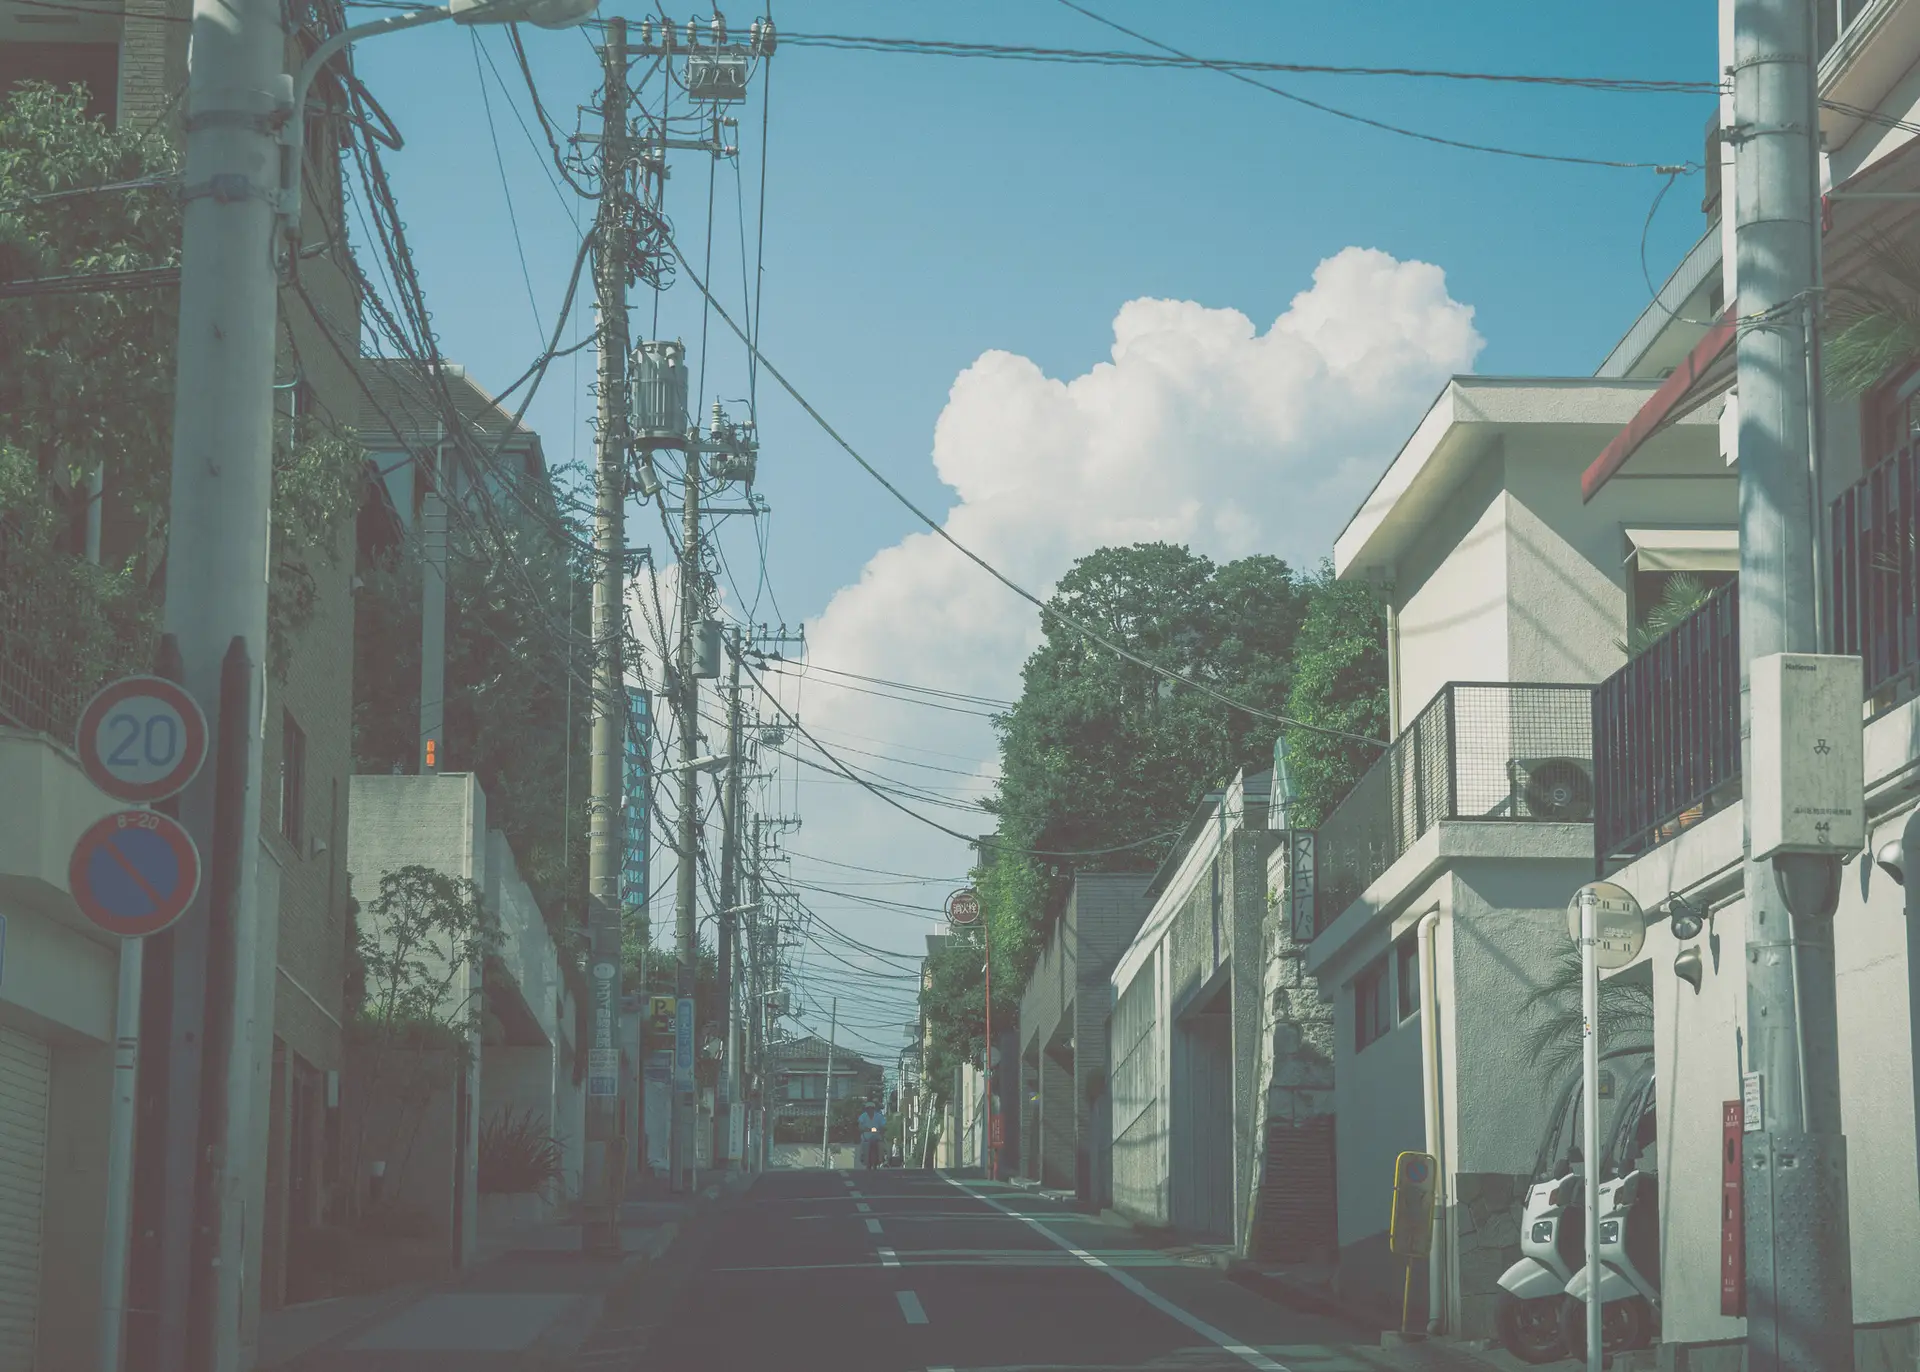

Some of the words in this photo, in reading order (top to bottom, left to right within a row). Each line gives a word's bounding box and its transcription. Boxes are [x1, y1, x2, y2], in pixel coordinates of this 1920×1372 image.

[106, 713, 177, 767] 20
[117, 812, 160, 830] 8-20
[1815, 821, 1830, 831] 44
[1295, 837, 1313, 934] ヌキテパ
[953, 902, 977, 915] 消火栓
